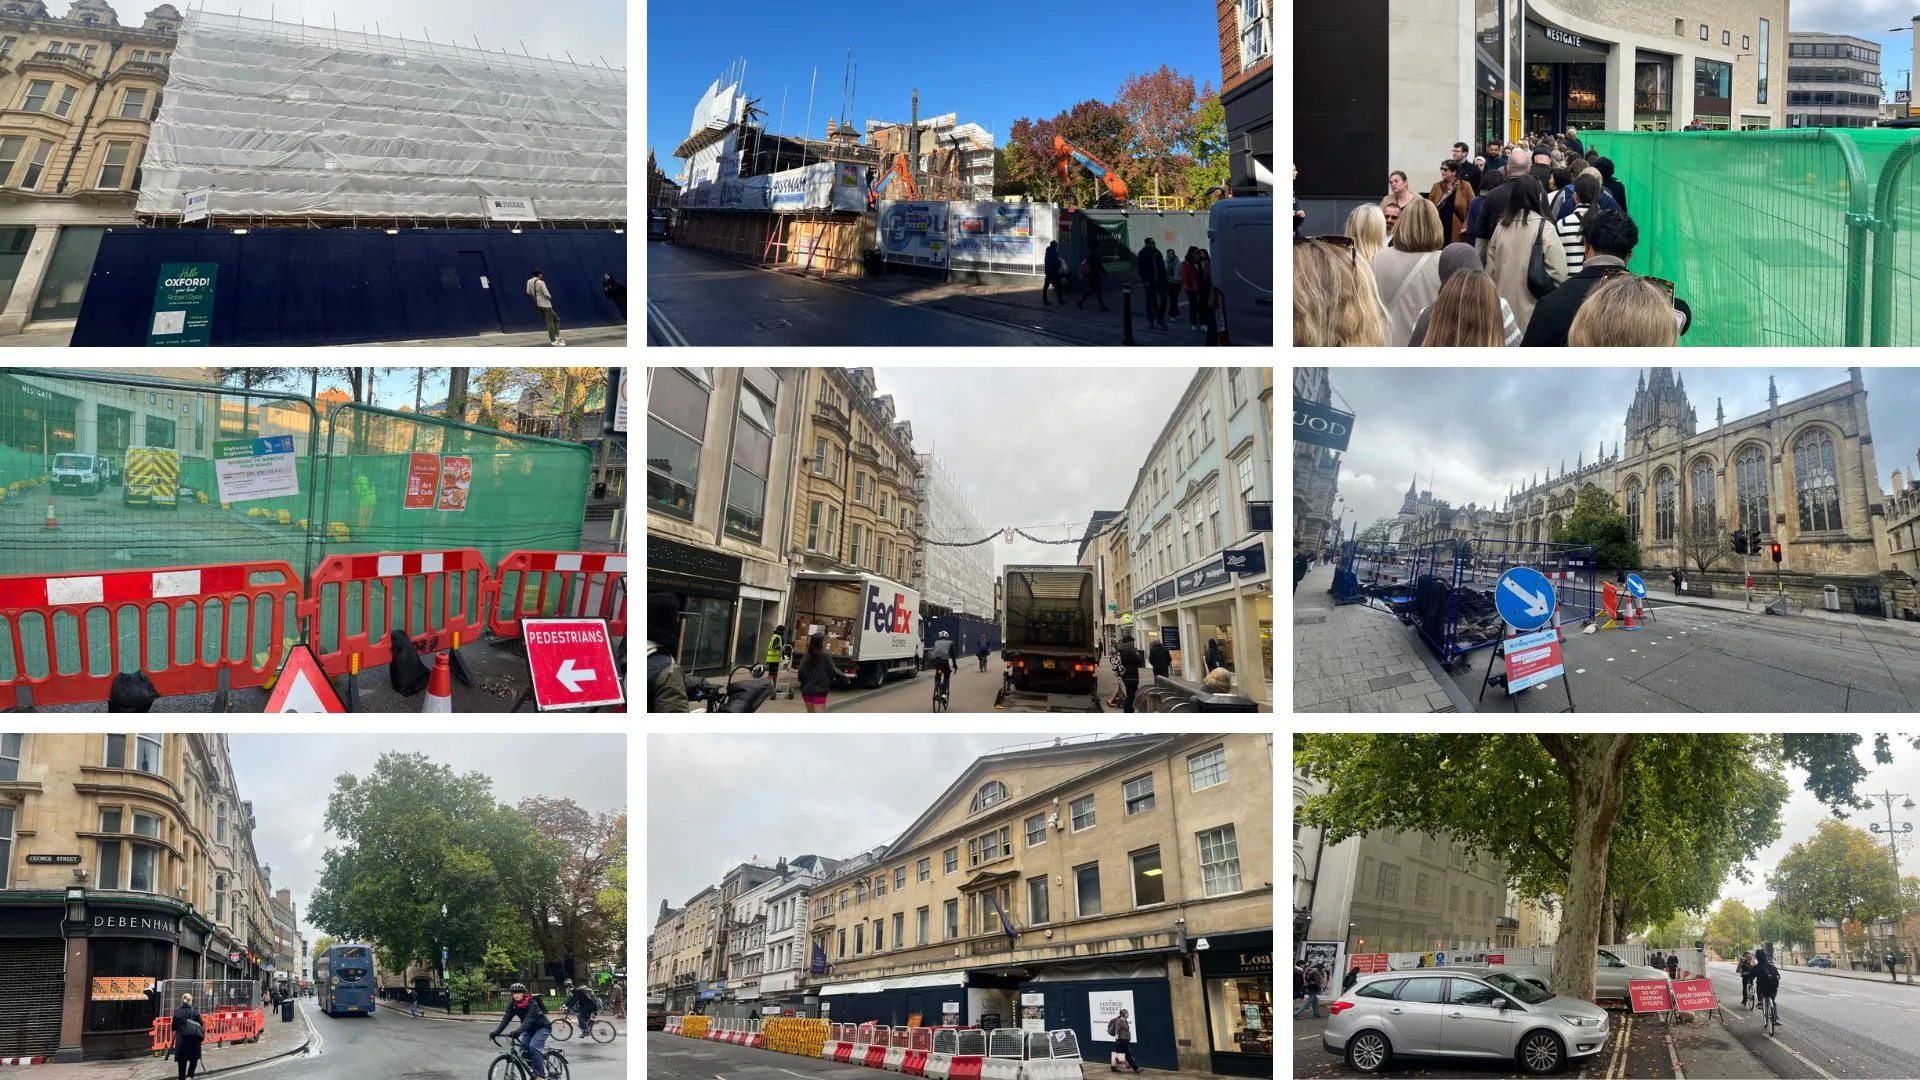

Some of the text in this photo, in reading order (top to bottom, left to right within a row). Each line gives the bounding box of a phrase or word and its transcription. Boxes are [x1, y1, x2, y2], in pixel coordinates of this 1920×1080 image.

[1546, 27, 1581, 47] WESTGATE
[165, 278, 210, 287] OXFORD!
[21, 384, 53, 400] WESTGATE
[223, 449, 254, 457] Engineering
[864, 584, 912, 634] FedEx
[529, 631, 604, 644] PEDESTRIANS
[891, 636, 907, 649] Express
[1676, 991, 1712, 999] OVERTAKING
